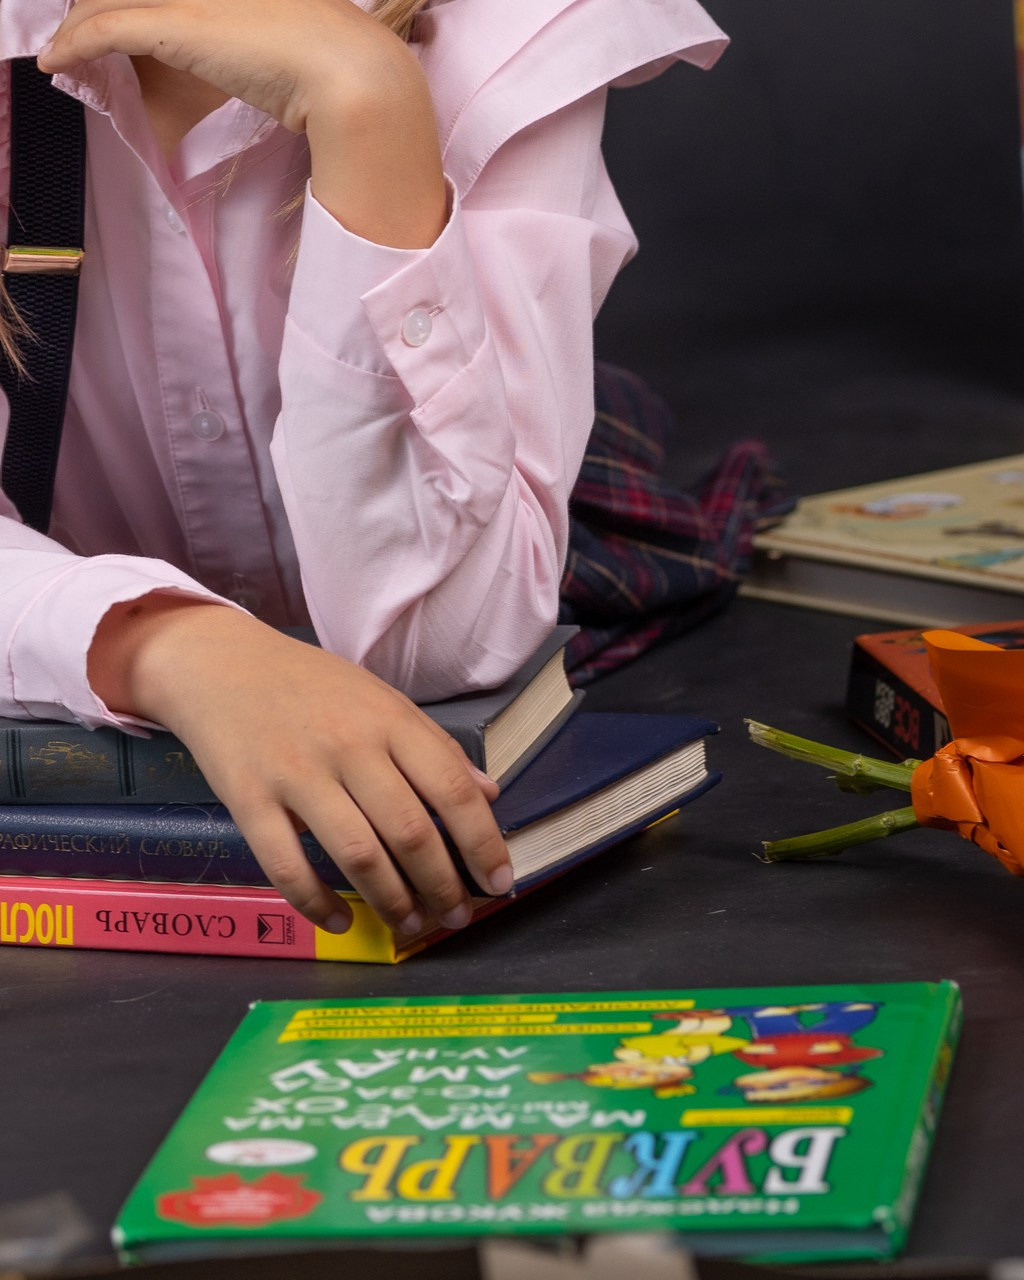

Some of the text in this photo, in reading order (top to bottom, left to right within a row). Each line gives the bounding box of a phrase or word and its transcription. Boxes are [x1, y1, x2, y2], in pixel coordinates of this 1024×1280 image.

[138, 837, 231, 859] СЛОВАРЬ
[95, 910, 237, 939] СЛОВАРЬ
[339, 1126, 847, 1202] БУКВАРЬ
